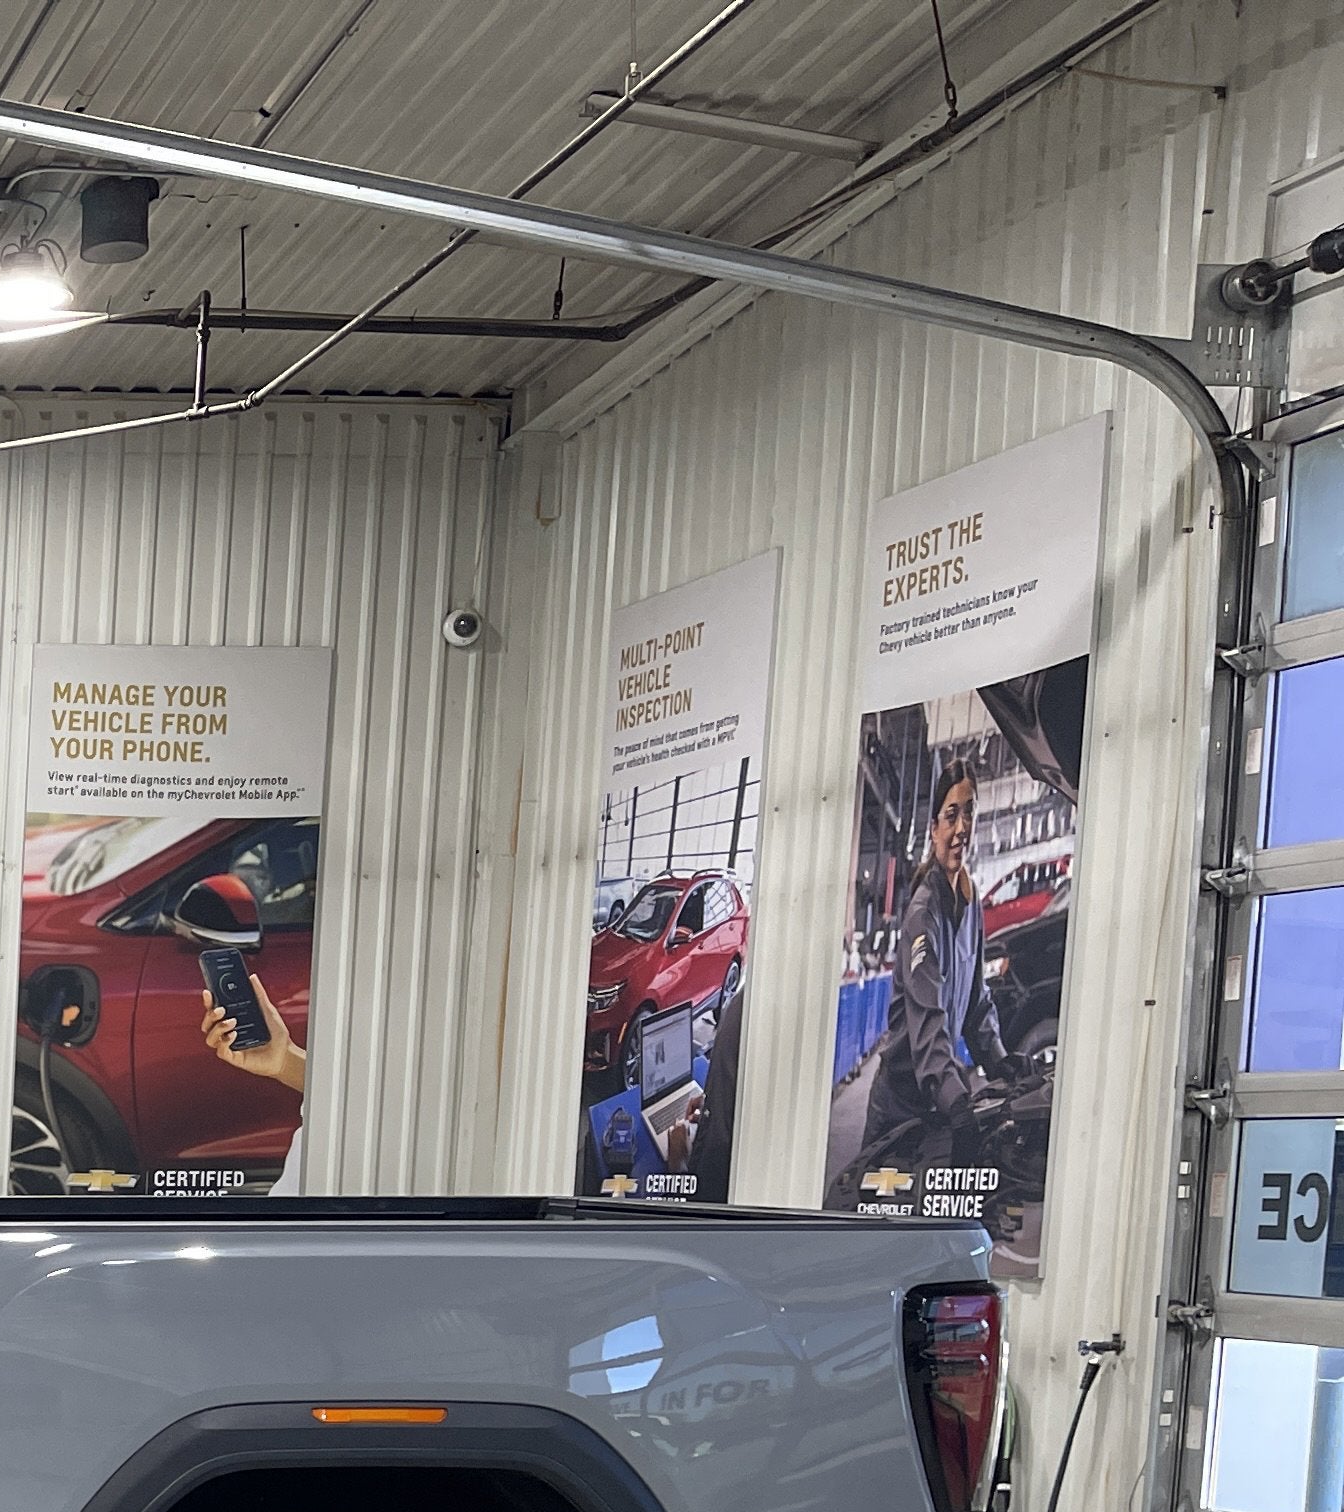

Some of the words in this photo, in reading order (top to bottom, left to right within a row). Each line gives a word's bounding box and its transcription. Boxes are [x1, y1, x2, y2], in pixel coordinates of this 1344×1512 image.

[886, 527, 942, 571] TRUST
[948, 512, 984, 549] THE
[883, 556, 968, 607] EXPERTS.
[880, 619, 910, 636] Factory
[912, 609, 940, 627] trained
[942, 595, 990, 619] technicians
[992, 587, 1015, 603] know
[1016, 579, 1038, 599] your
[879, 639, 903, 654] Chevy
[905, 631, 932, 648] vehicle
[934, 622, 960, 640] better
[962, 616, 980, 631] than
[983, 606, 1016, 626] anyone.
[620, 622, 704, 672] MULTI-POINT
[53, 682, 155, 706] MANAGE
[164, 685, 227, 707] YOUR
[618, 664, 671, 701] VEHICLE
[52, 709, 153, 734] VEHICLE
[162, 713, 227, 735] FROM
[616, 688, 692, 732] INSPECTION
[50, 737, 113, 760] YOUR
[123, 740, 210, 763] PHONE.
[48, 771, 73, 782] View
[76, 772, 127, 784] real-time
[130, 773, 192, 788] diagnostics
[195, 776, 215, 785] and
[218, 776, 246, 788] enjoy
[249, 776, 288, 785] remote
[81, 787, 127, 799] available
[131, 790, 144, 799] on
[147, 789, 164, 799] the
[168, 789, 235, 801] myChevrolet
[239, 789, 273, 800] Mobile
[154, 1170, 244, 1187] CERTIFIED
[646, 1175, 697, 1194] CERTIFIED
[926, 1168, 999, 1191] CERTIFIED
[857, 1203, 914, 1216] CHEVROLET
[923, 1195, 983, 1218] SERVICE
